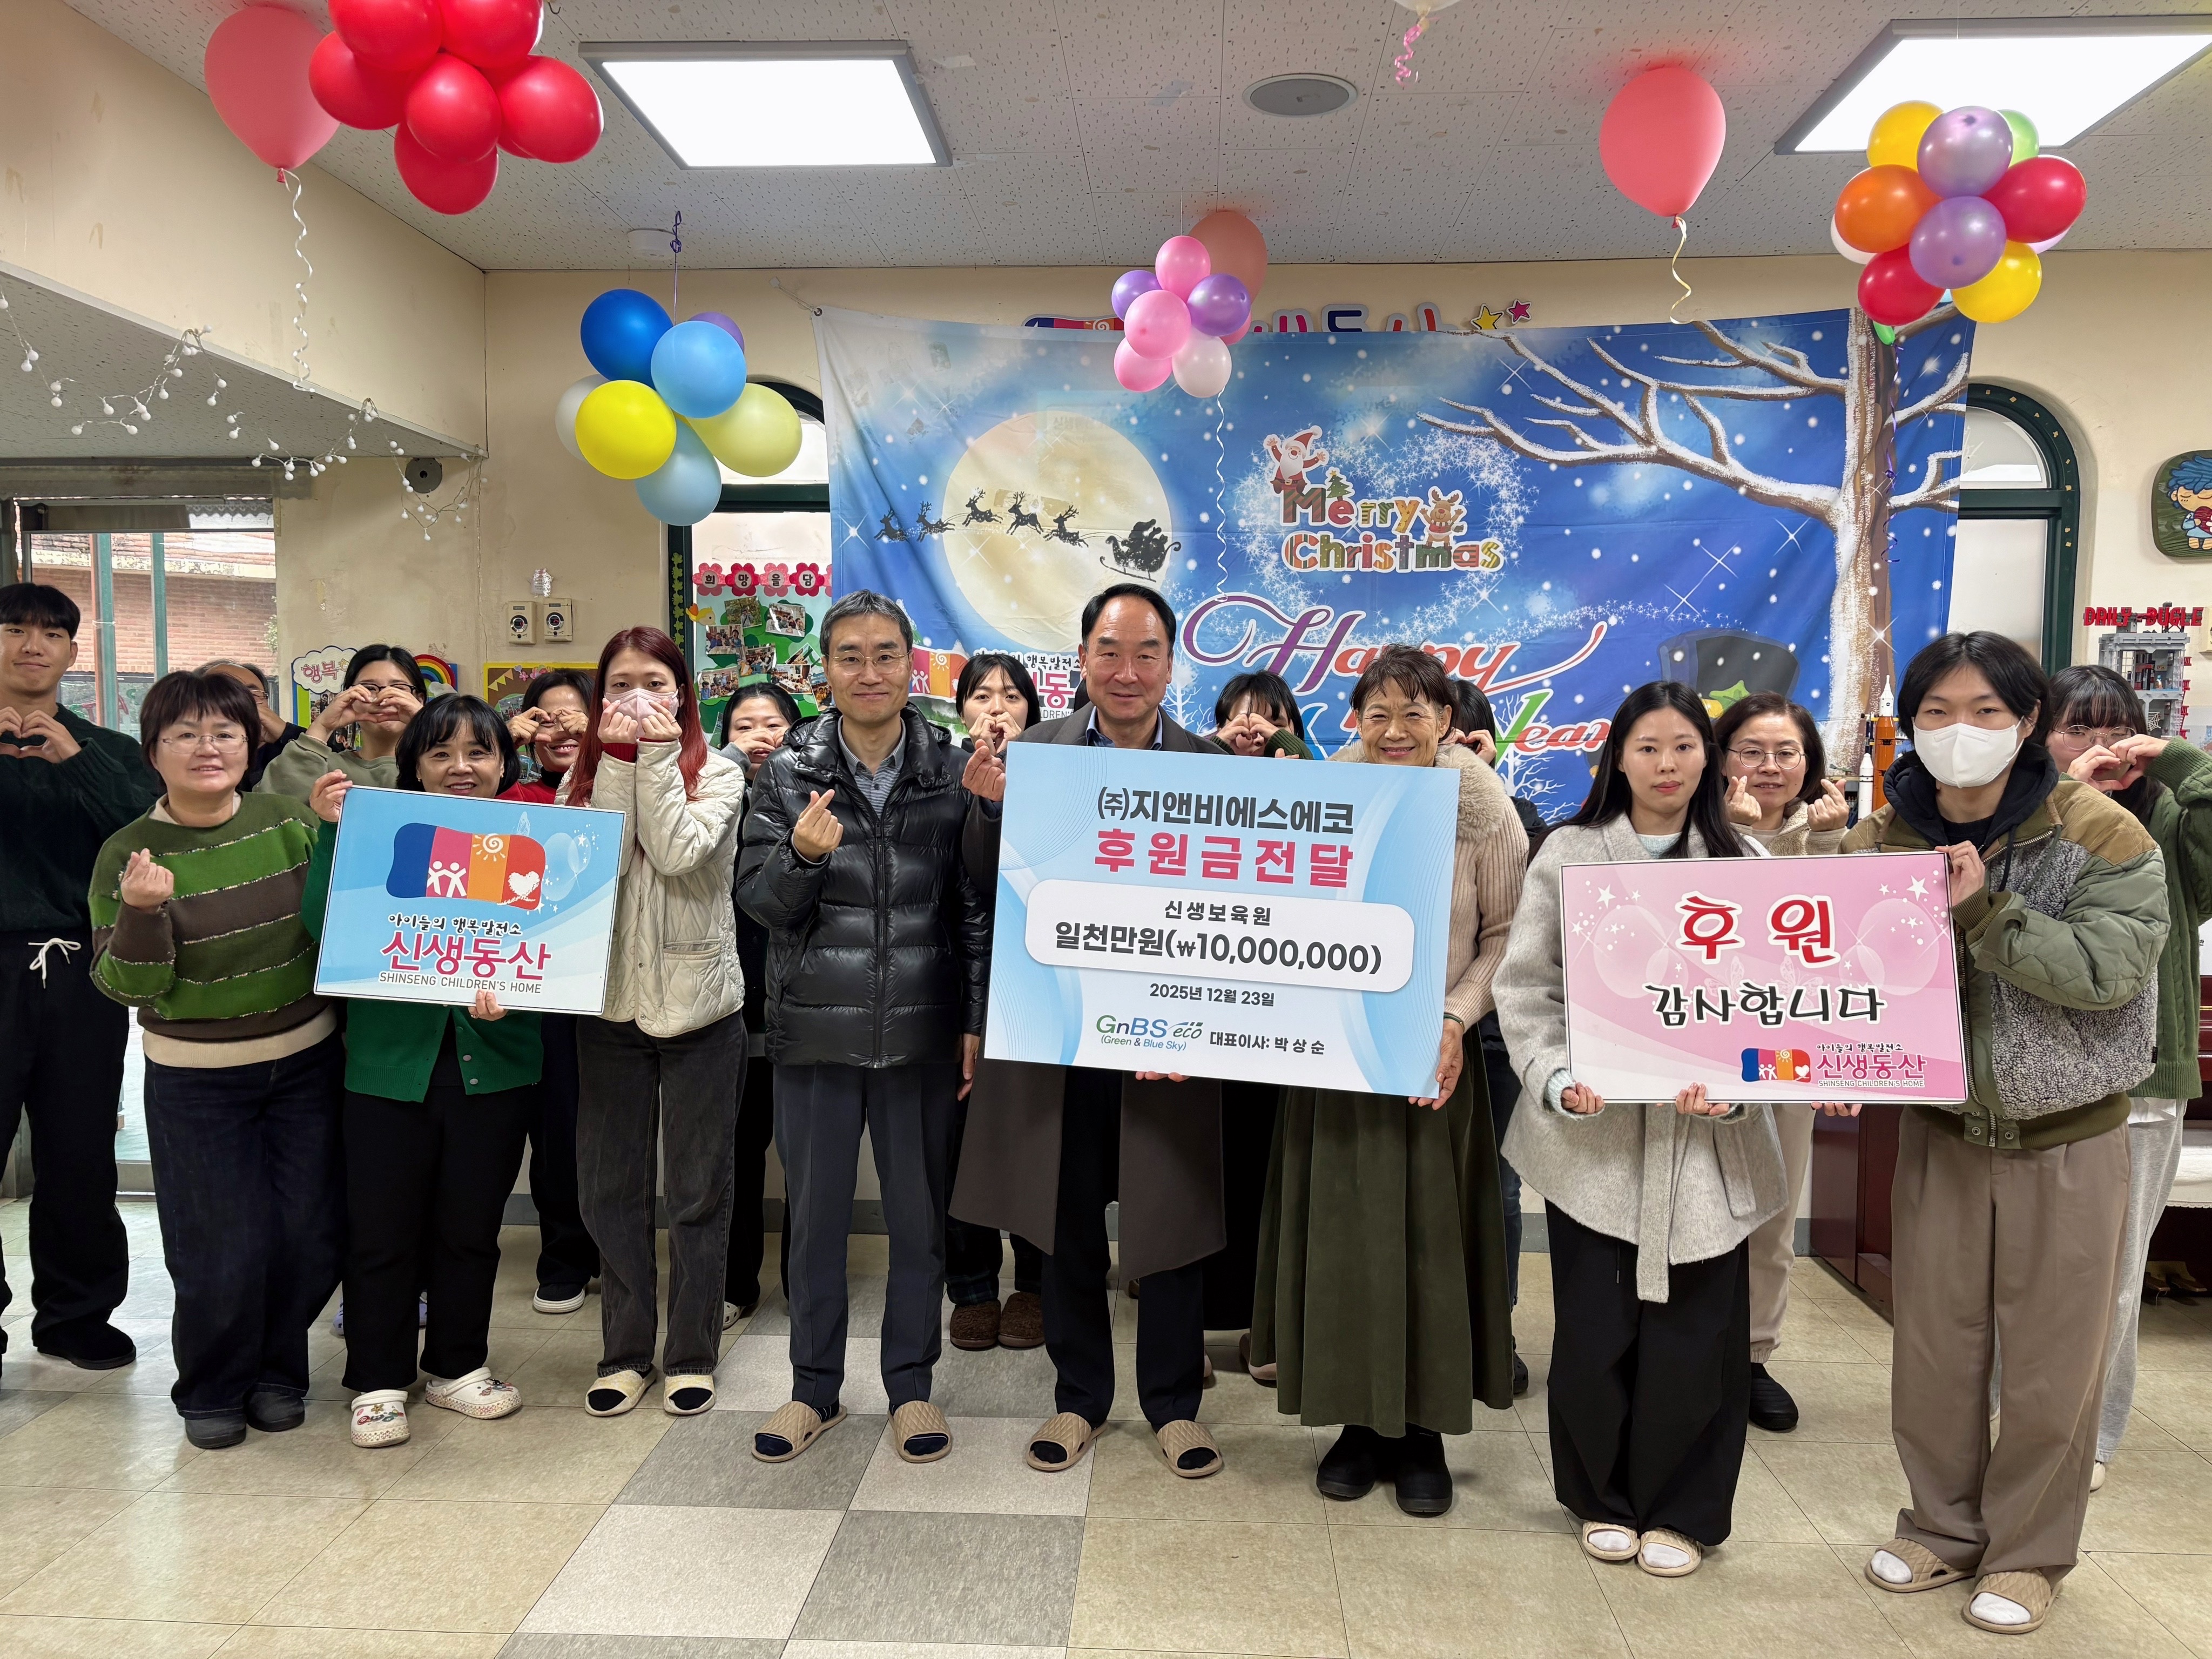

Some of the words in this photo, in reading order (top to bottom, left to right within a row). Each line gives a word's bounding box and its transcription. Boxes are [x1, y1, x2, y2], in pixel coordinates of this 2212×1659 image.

[1282, 487, 1420, 534] Merry
[1284, 534, 1501, 569] Christmas
[2083, 606, 2132, 626] DAILY
[2145, 606, 2204, 626] BUGLE
[301, 660, 339, 684] 행복
[1097, 786, 1354, 834] (주)지앤비에스에코
[389, 913, 446, 930] 아이들의
[453, 917, 522, 936] 행복발전소
[1165, 900, 1271, 926] 신생보육원
[382, 932, 551, 981] 신생동산
[379, 972, 436, 986] SHINSENG
[441, 977, 506, 991] CHILDREN'S
[510, 982, 542, 994] HOME
[1149, 983, 1202, 1001] 2025년
[1206, 987, 1237, 1004] 12월
[1241, 990, 1274, 1007] 23일
[1644, 981, 1885, 1026] 감사합니다
[1096, 1015, 1168, 1038] GnBS
[1172, 1026, 1203, 1039] eco
[1101, 1034, 1132, 1046] (Green
[1134, 1038, 1141, 1047] &
[1143, 1038, 1164, 1049] Blue
[1165, 1040, 1187, 1052] Sky)
[1210, 1031, 1270, 1050] 대표이사:
[1817, 1043, 1852, 1053] 아이들의
[1857, 1043, 1903, 1053] 행복발전소
[1816, 1054, 1926, 1080] 신생동산
